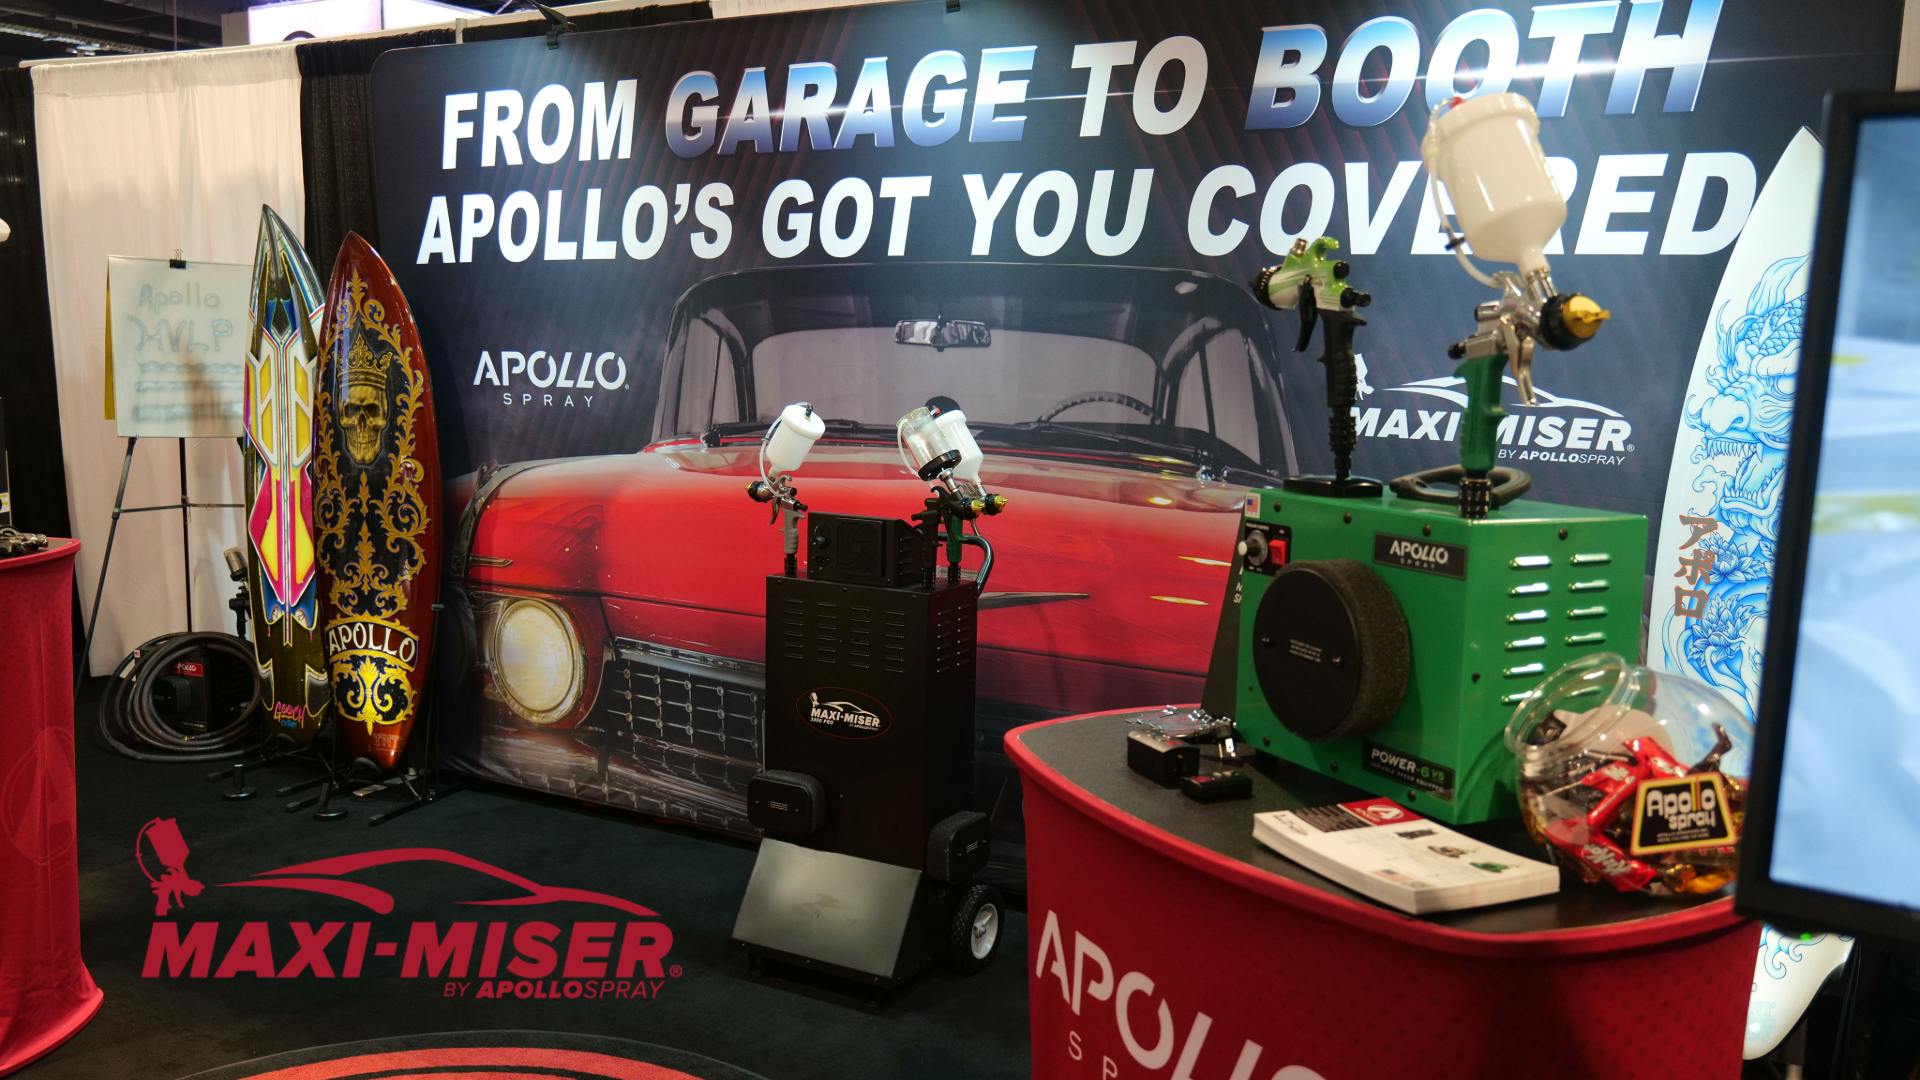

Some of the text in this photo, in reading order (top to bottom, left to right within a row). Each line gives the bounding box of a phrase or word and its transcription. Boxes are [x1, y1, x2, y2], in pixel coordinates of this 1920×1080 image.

[441, 0, 1724, 170] FROM GARAGE TO BOOTH
[416, 182, 734, 265] APOLLO'S
[762, 176, 932, 258] GOT
[962, 168, 1153, 256] YOU
[138, 281, 221, 314] Apollo
[473, 350, 627, 391] APOLLO
[503, 393, 593, 407] SPRAY
[1350, 407, 1632, 452] MAXIMISER
[1498, 449, 1626, 467] BY APOLLOSPRAY
[1389, 539, 1449, 565] APOLLO
[1674, 514, 1718, 619] アポロ
[328, 622, 416, 662] APOLLO
[1646, 781, 1717, 820] Apollo
[1668, 810, 1716, 831] spray
